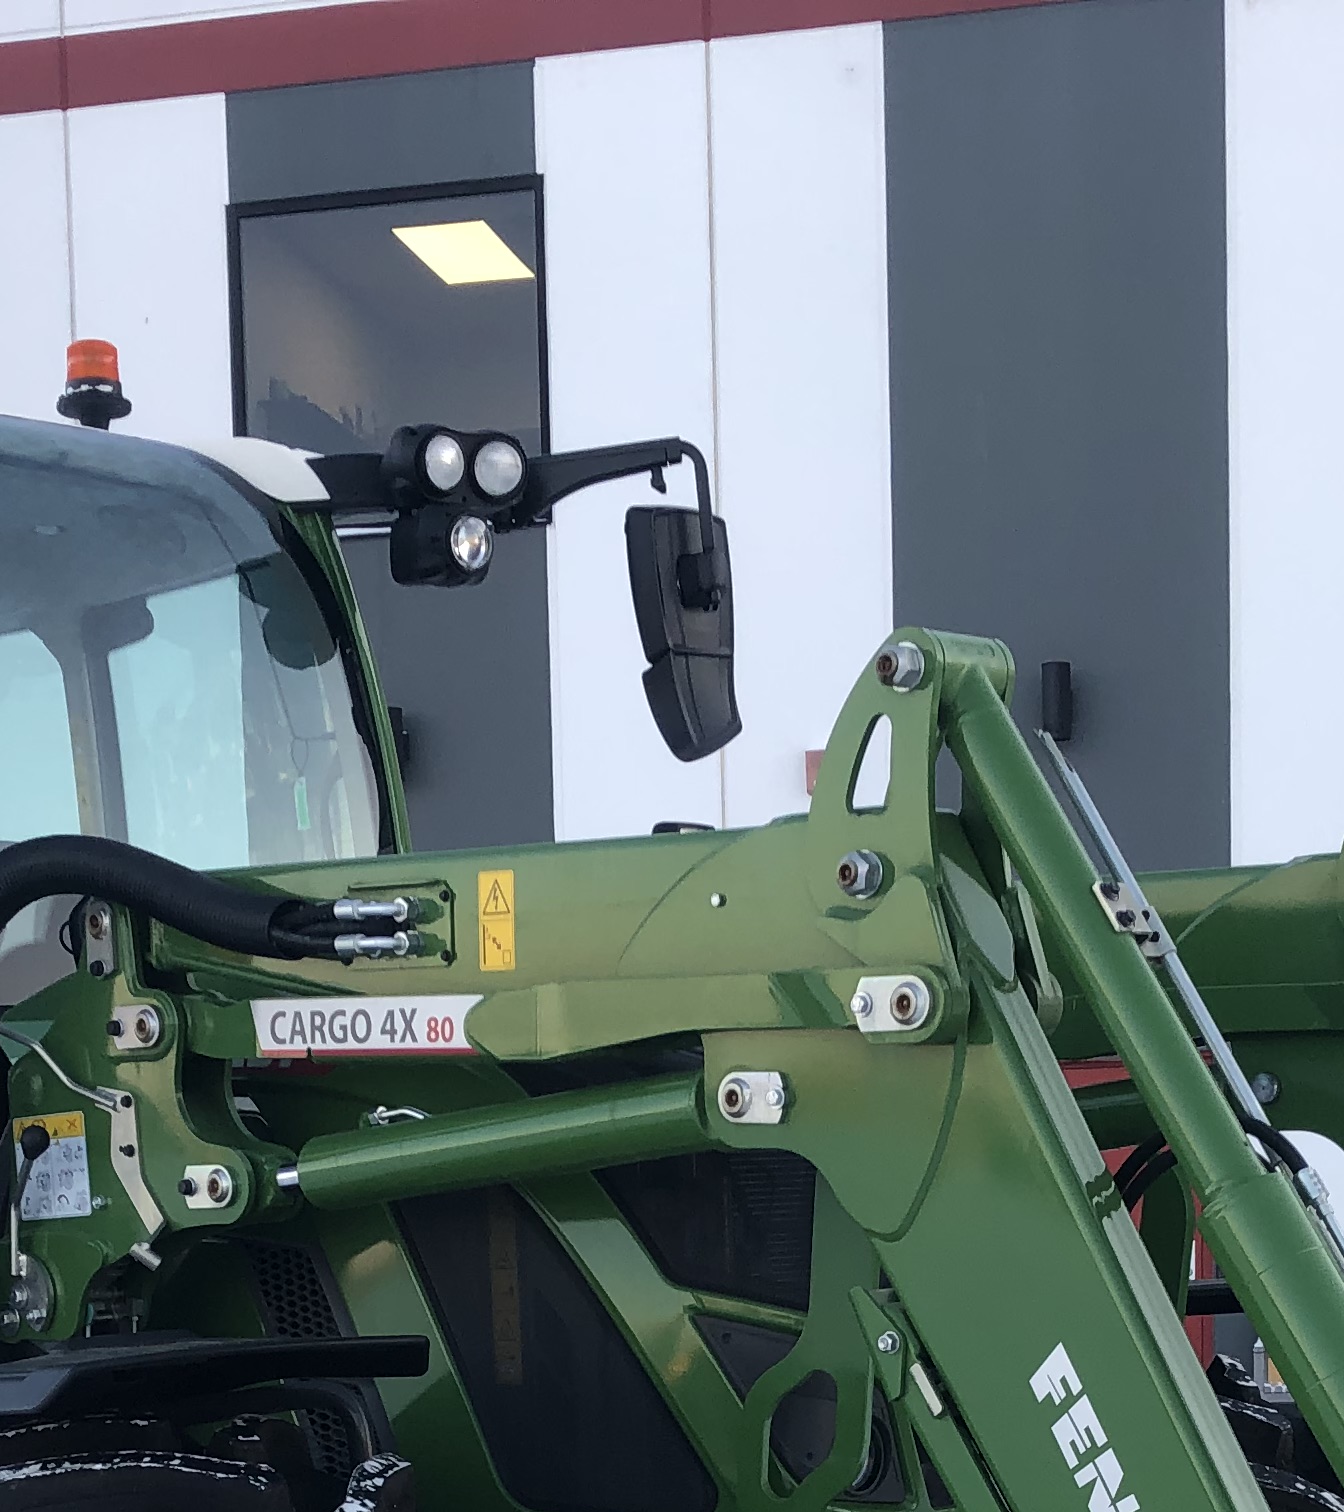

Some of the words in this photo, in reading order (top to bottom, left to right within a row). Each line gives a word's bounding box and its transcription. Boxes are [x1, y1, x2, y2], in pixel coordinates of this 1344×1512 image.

[269, 1009, 372, 1045] CARGO
[380, 1007, 418, 1043] 4X
[426, 1016, 454, 1043] 80
